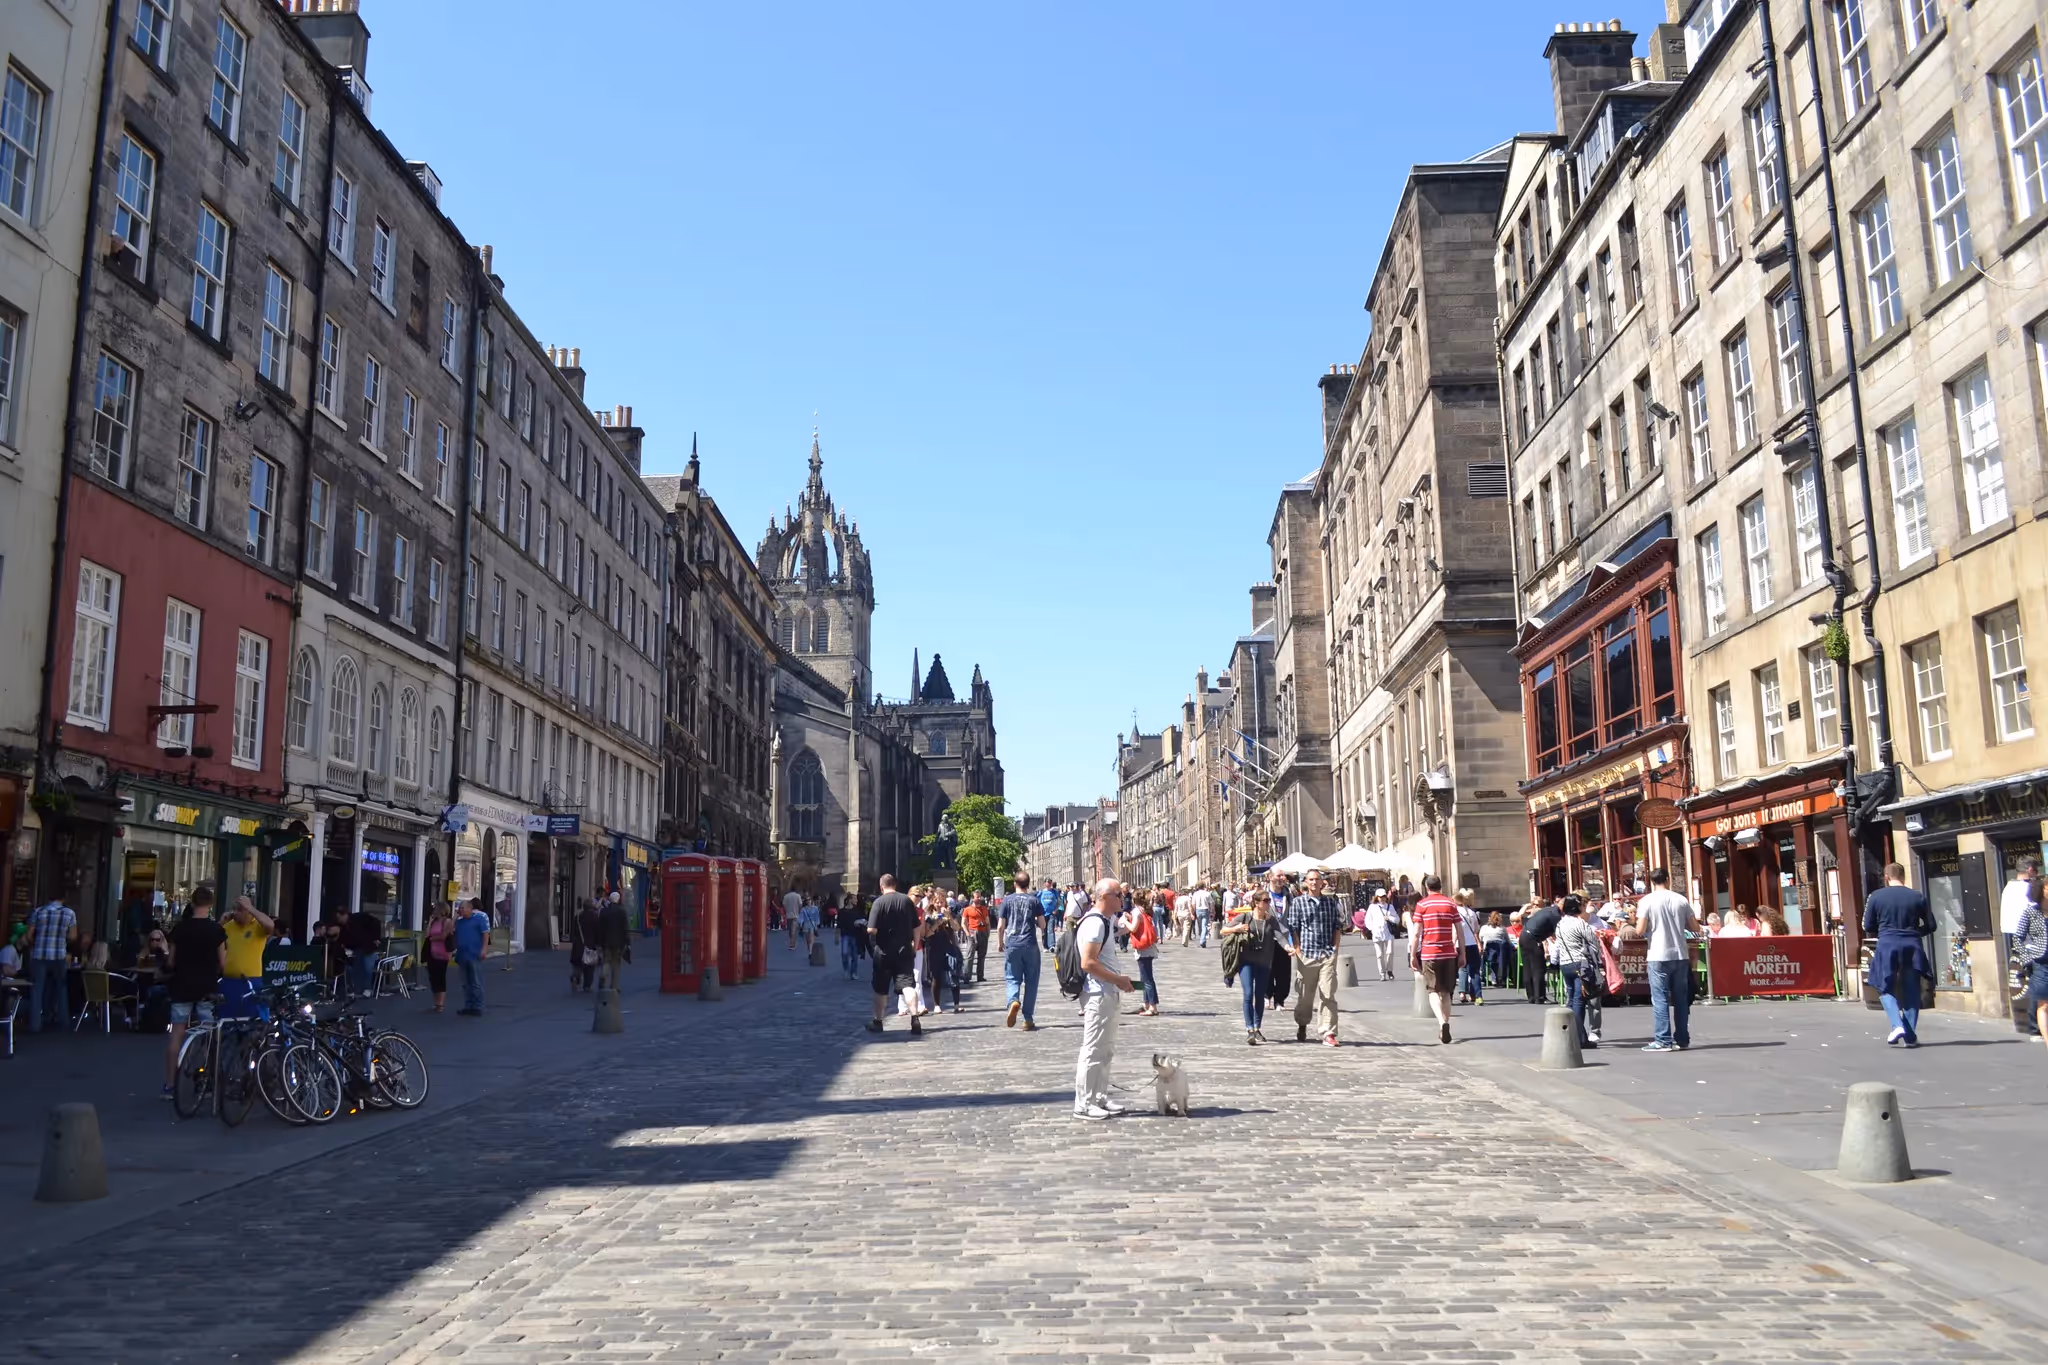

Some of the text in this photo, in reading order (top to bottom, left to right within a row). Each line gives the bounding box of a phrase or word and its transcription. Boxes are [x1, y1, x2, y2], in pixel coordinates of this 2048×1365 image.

[155, 802, 198, 827] SUBWAY
[366, 812, 376, 824] OF
[379, 815, 405, 831] BENGAL
[221, 815, 260, 837] SUBWAY
[272, 839, 303, 859] SUBWAY
[370, 851, 377, 862] OF
[379, 851, 399, 865] BENGAL
[1941, 862, 1960, 873] SPIRI
[1756, 954, 1789, 962] BIRRA
[265, 960, 311, 971] SUBWAY
[1743, 961, 1801, 975] MORETTI
[271, 972, 317, 986] eat fresh.
